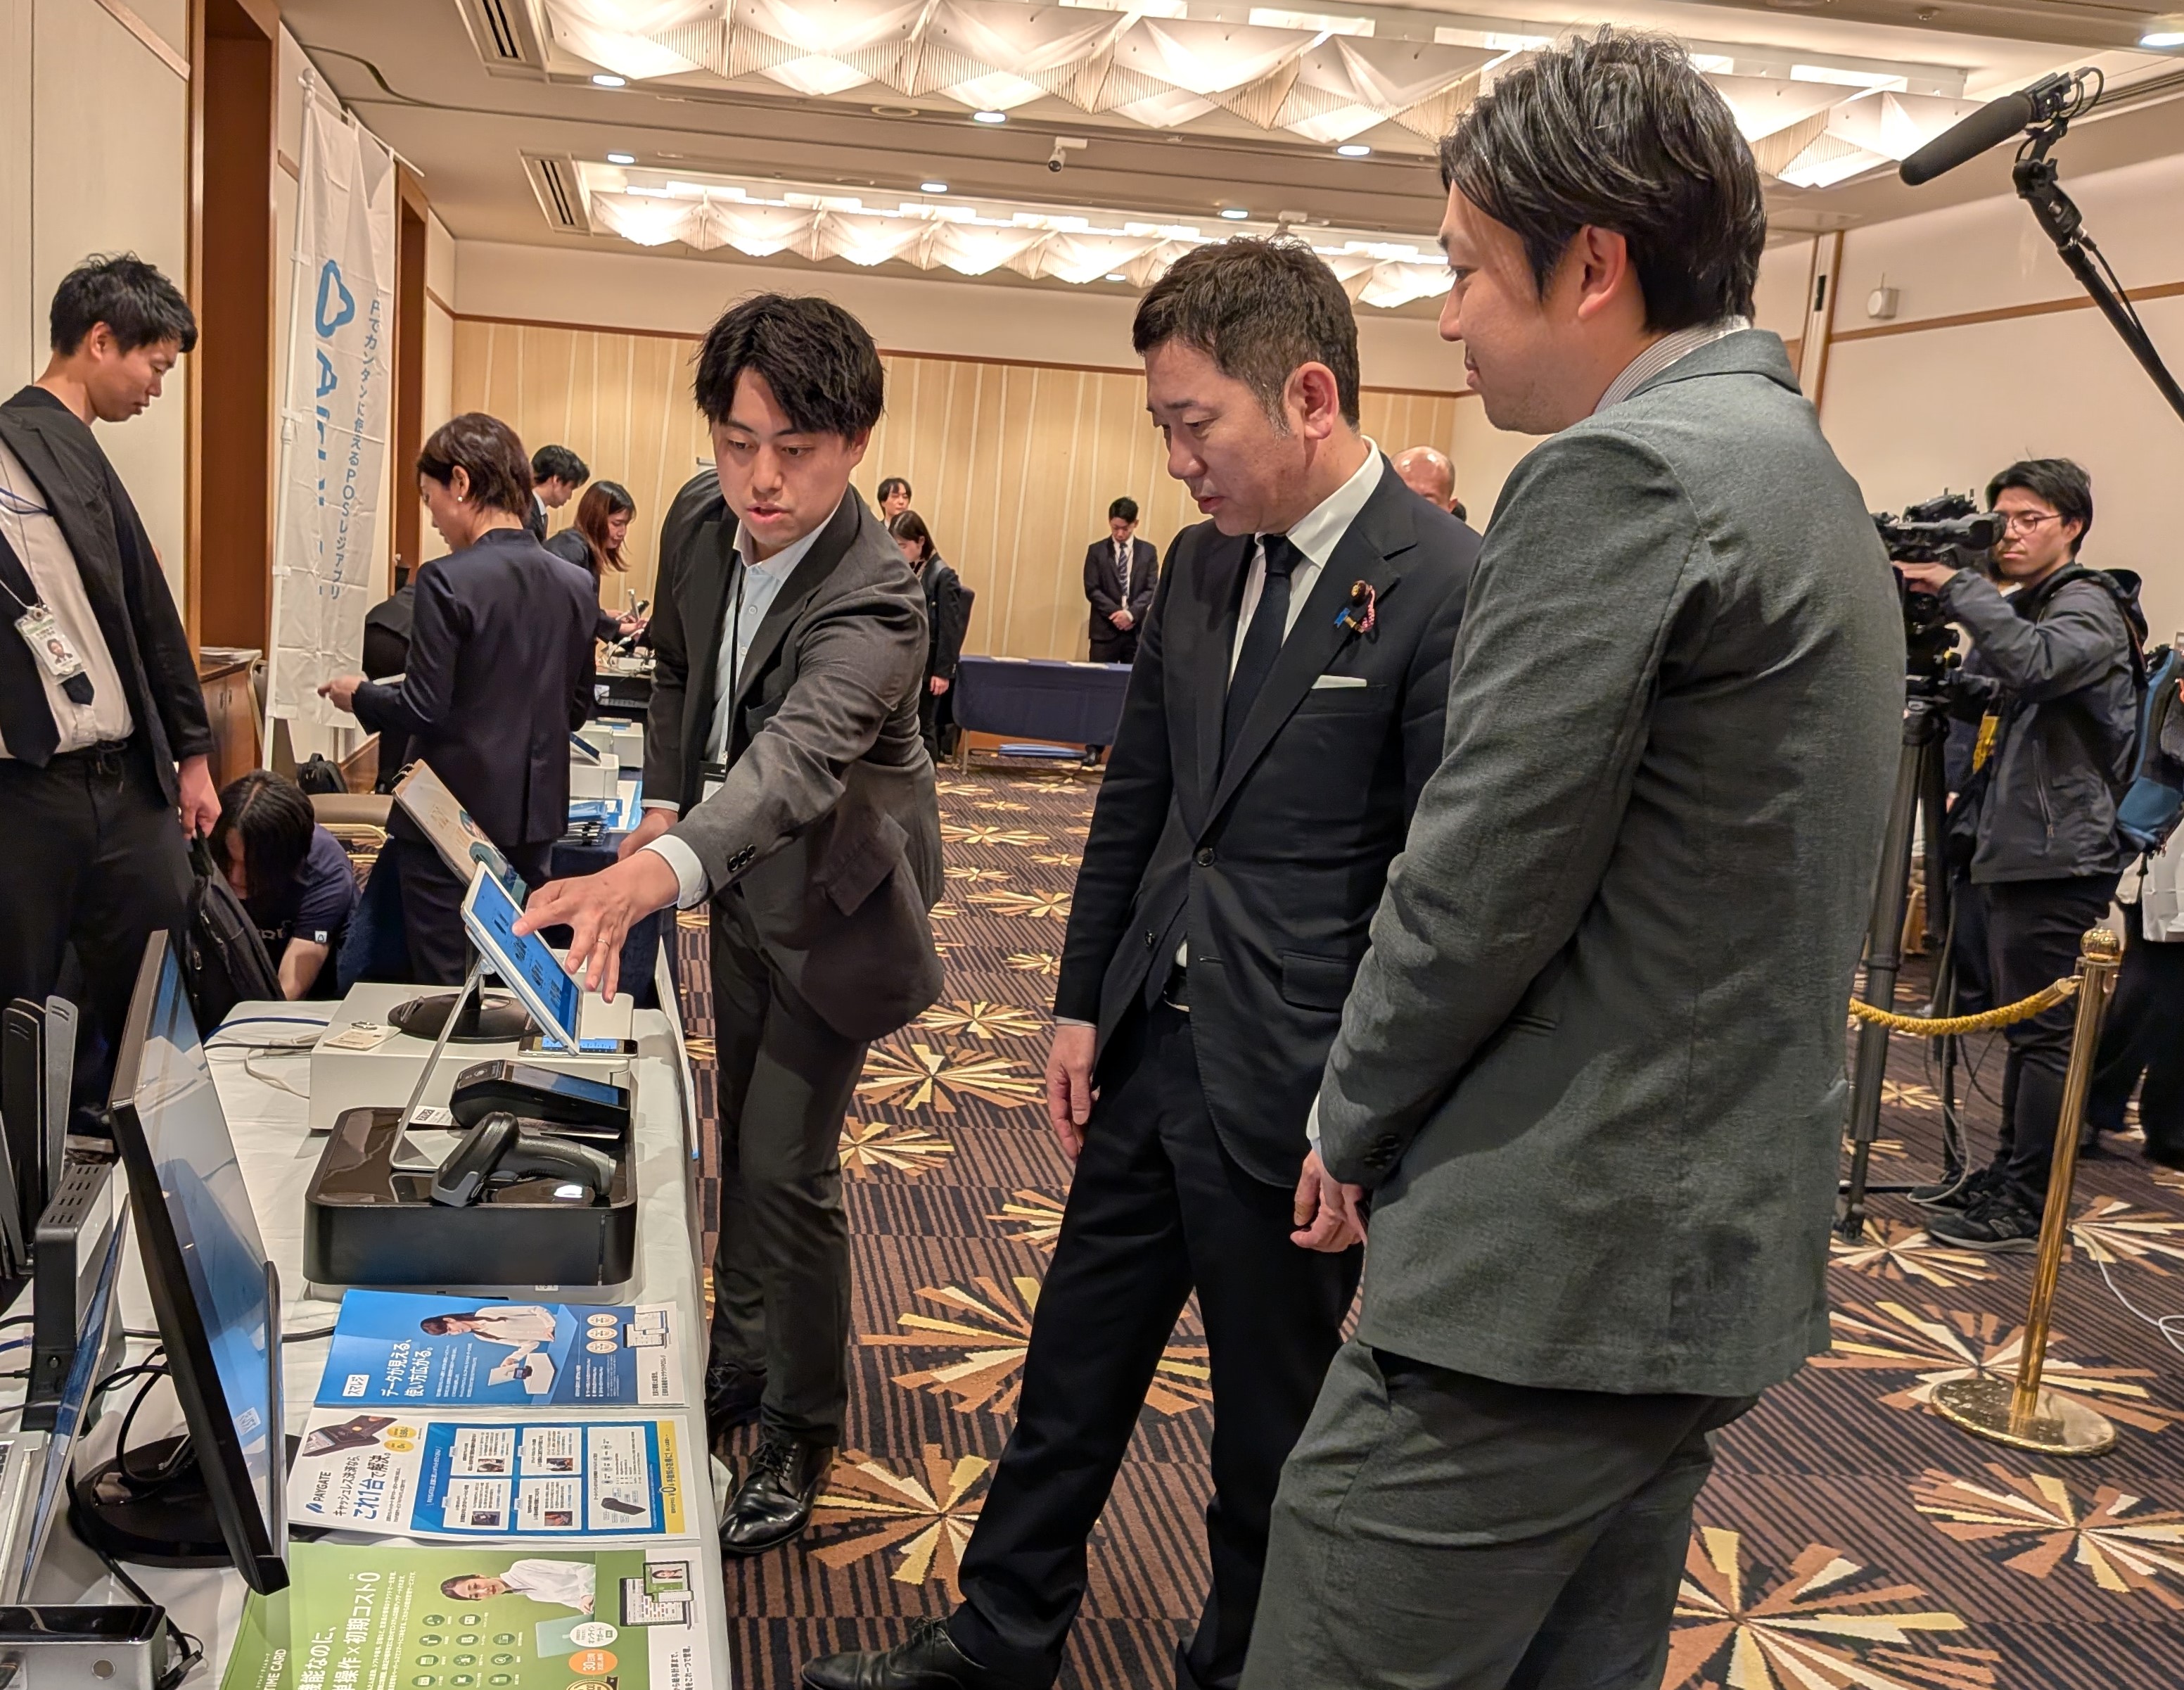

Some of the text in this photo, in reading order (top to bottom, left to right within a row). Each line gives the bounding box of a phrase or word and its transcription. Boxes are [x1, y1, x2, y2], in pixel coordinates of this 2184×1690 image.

[331, 288, 381, 599] 円でカンタンに使えるPOSレジアプリ
[348, 1376, 364, 1394] スマレジ
[381, 1340, 411, 1397] データが見える、
[404, 1347, 433, 1397] 使い方広がる。
[313, 1471, 331, 1502] PAYGATE
[333, 1456, 360, 1516] キャッシュレス決済なら、
[353, 1452, 391, 1519] これ1台で解決。
[270, 1648, 287, 1670] CARD
[583, 1653, 595, 1671] 30日間
